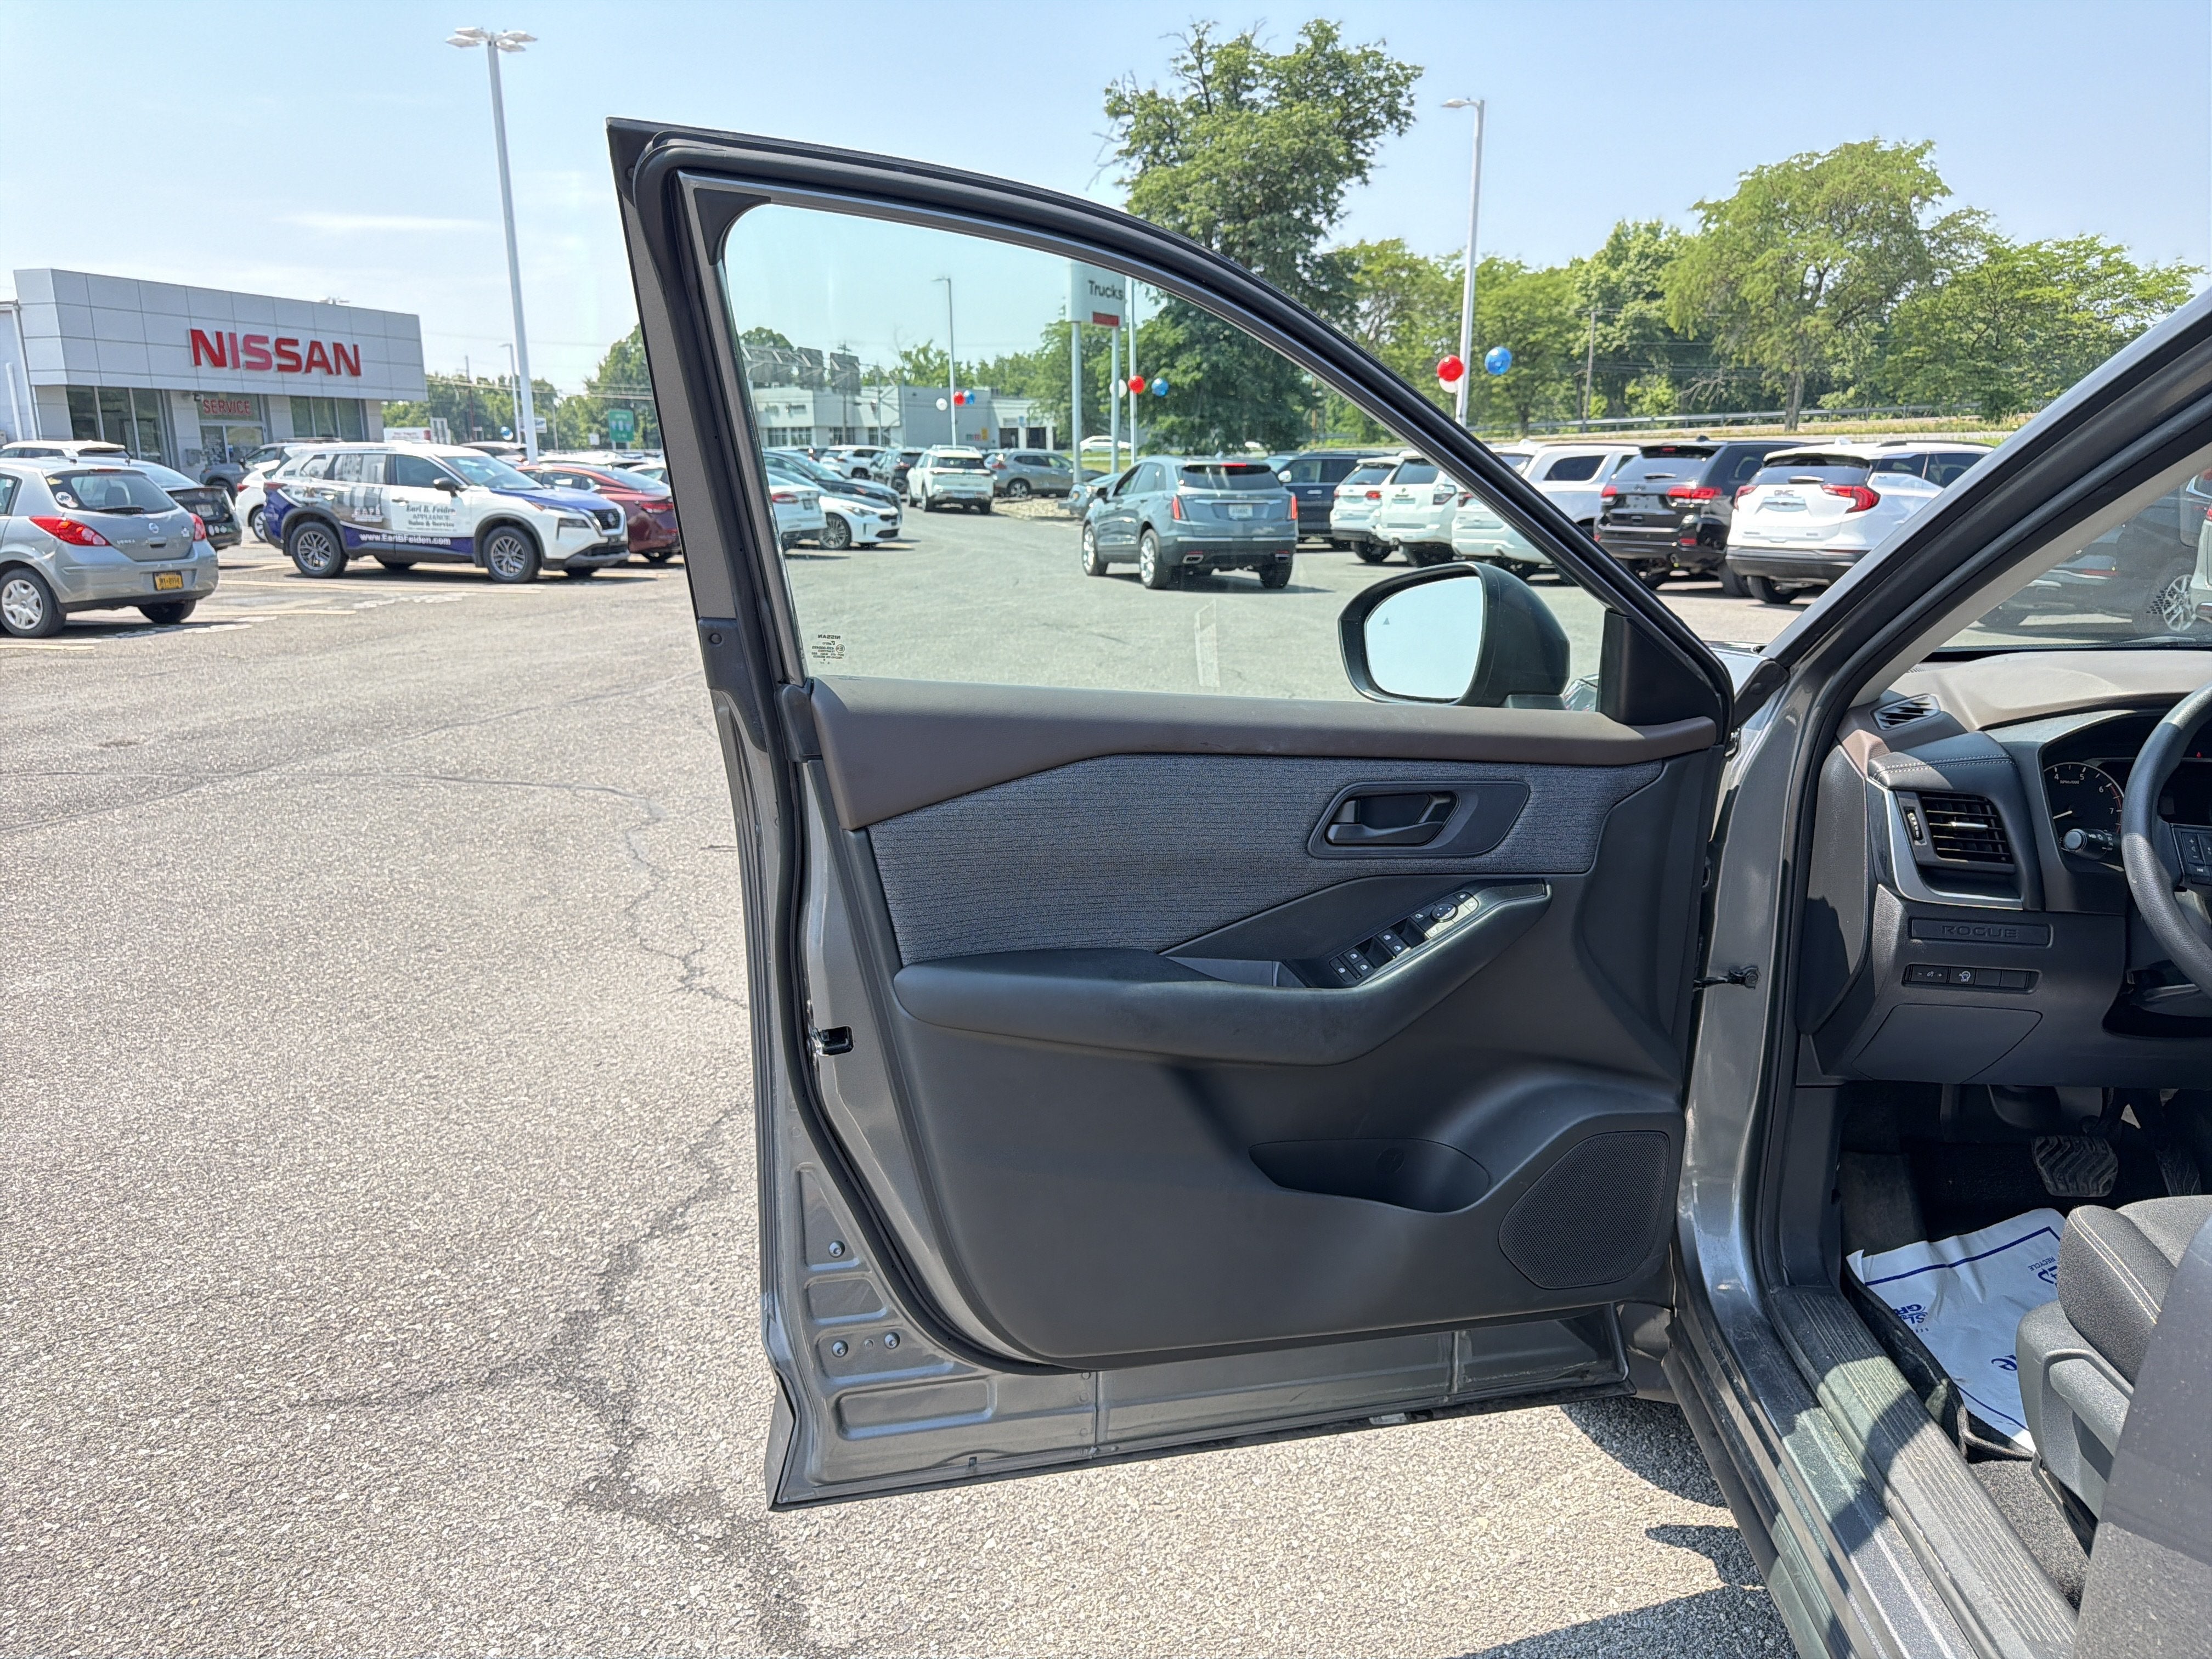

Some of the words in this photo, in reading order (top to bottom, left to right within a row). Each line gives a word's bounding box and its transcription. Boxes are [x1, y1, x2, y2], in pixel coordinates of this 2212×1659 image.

[1088, 280, 1124, 301] Trucks
[190, 329, 362, 376] NISSAN
[203, 399, 251, 415] SERVICE
[359, 534, 452, 546] www.EarlBFeiden.com
[1942, 925, 2018, 939] ROGUE
[2028, 1256, 2056, 1272] RECYCLE
